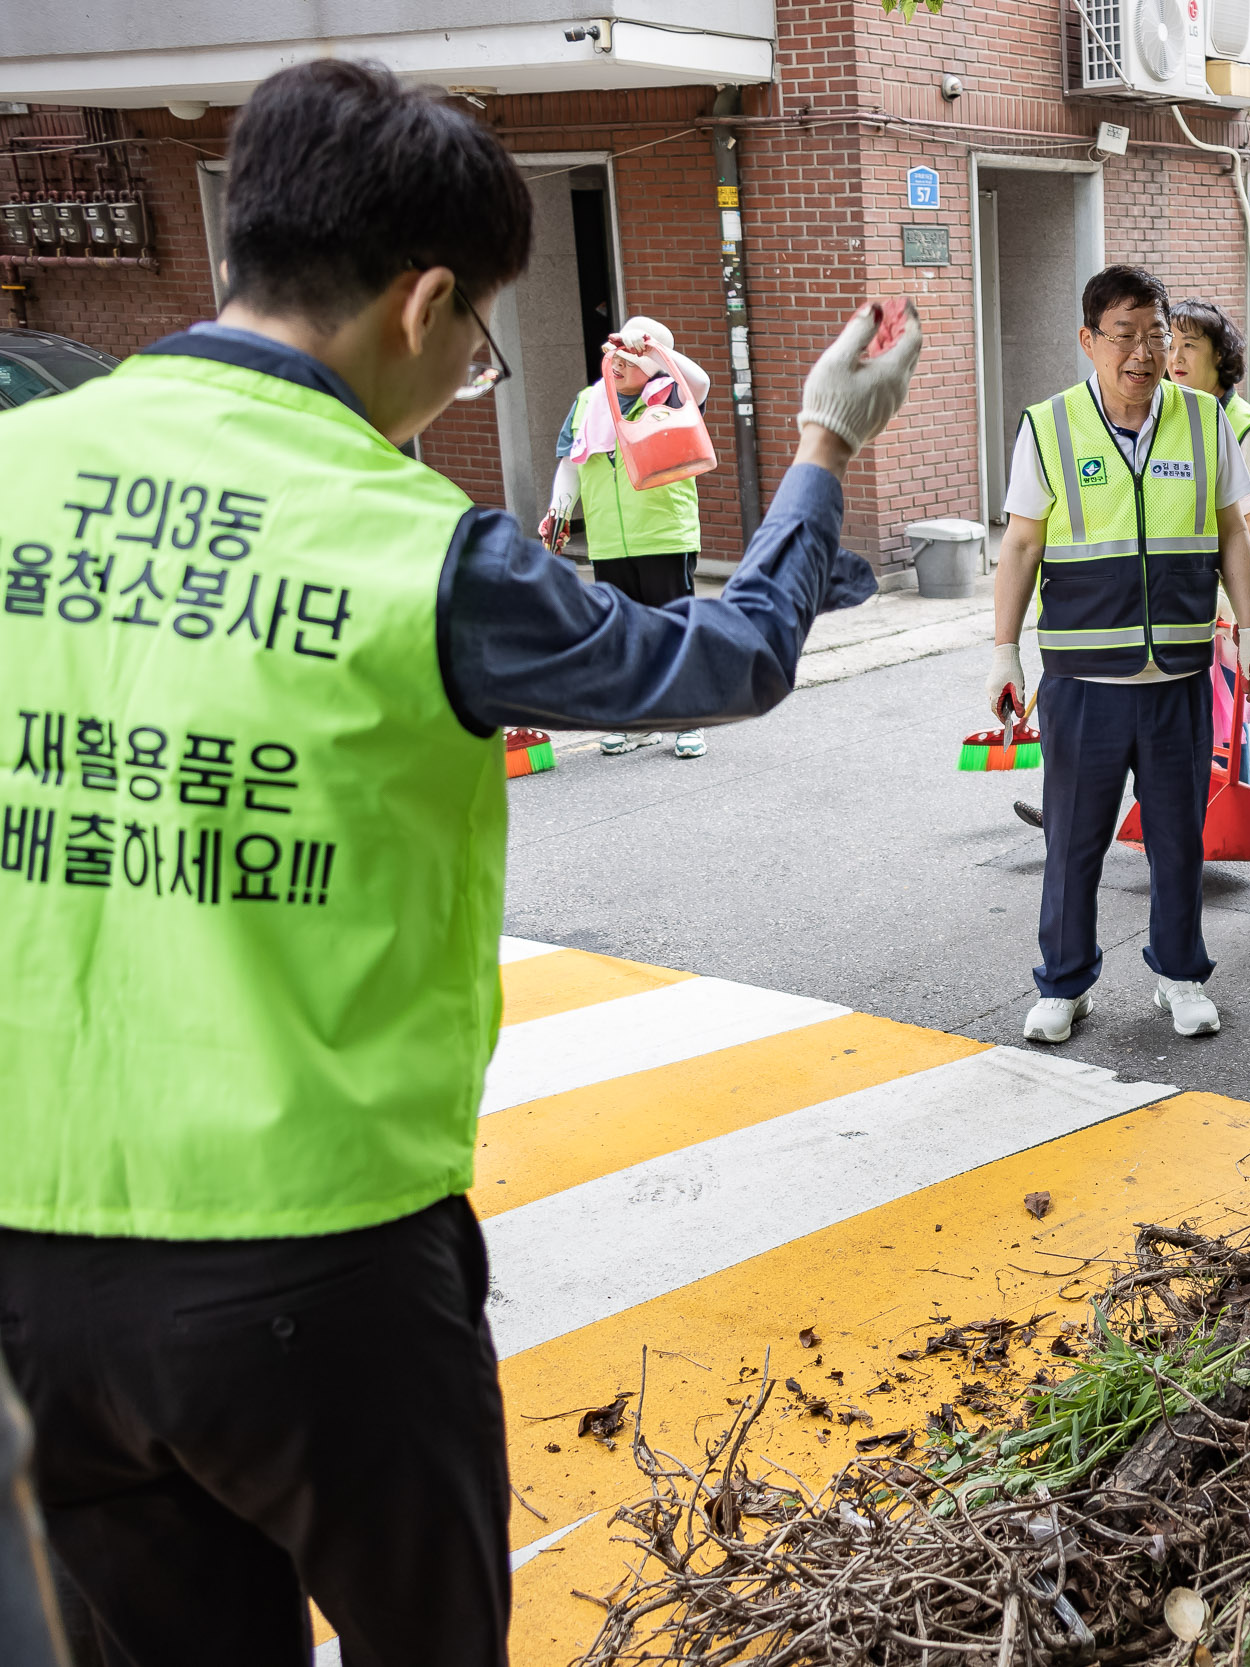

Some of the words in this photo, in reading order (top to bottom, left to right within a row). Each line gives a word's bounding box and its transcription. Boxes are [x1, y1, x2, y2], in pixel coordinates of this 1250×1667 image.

[1189, 26, 1198, 37] LG
[917, 187, 931, 203] 57
[63, 471, 268, 562] 구의3동
[0, 542, 352, 661] 율청소봉사단
[12, 709, 299, 814] 재활용품은
[1, 805, 337, 906] 배출하세요!!!
